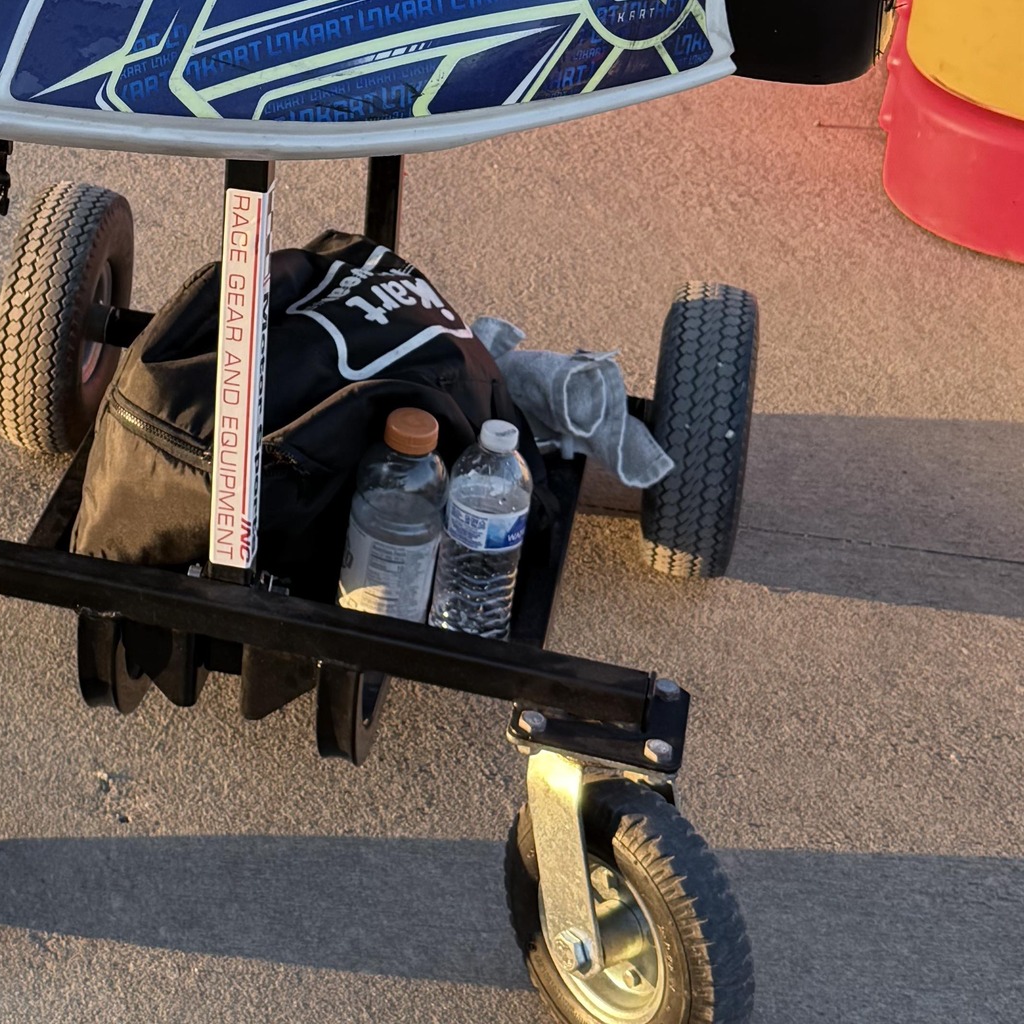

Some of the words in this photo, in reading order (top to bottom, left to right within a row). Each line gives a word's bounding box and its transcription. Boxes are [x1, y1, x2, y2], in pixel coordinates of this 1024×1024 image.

[617, 7, 655, 23] KART
[229, 194, 251, 263] RACE
[226, 273, 246, 343] GEAR
[222, 350, 242, 406] AND
[217, 415, 239, 560] EQUIPMENT
